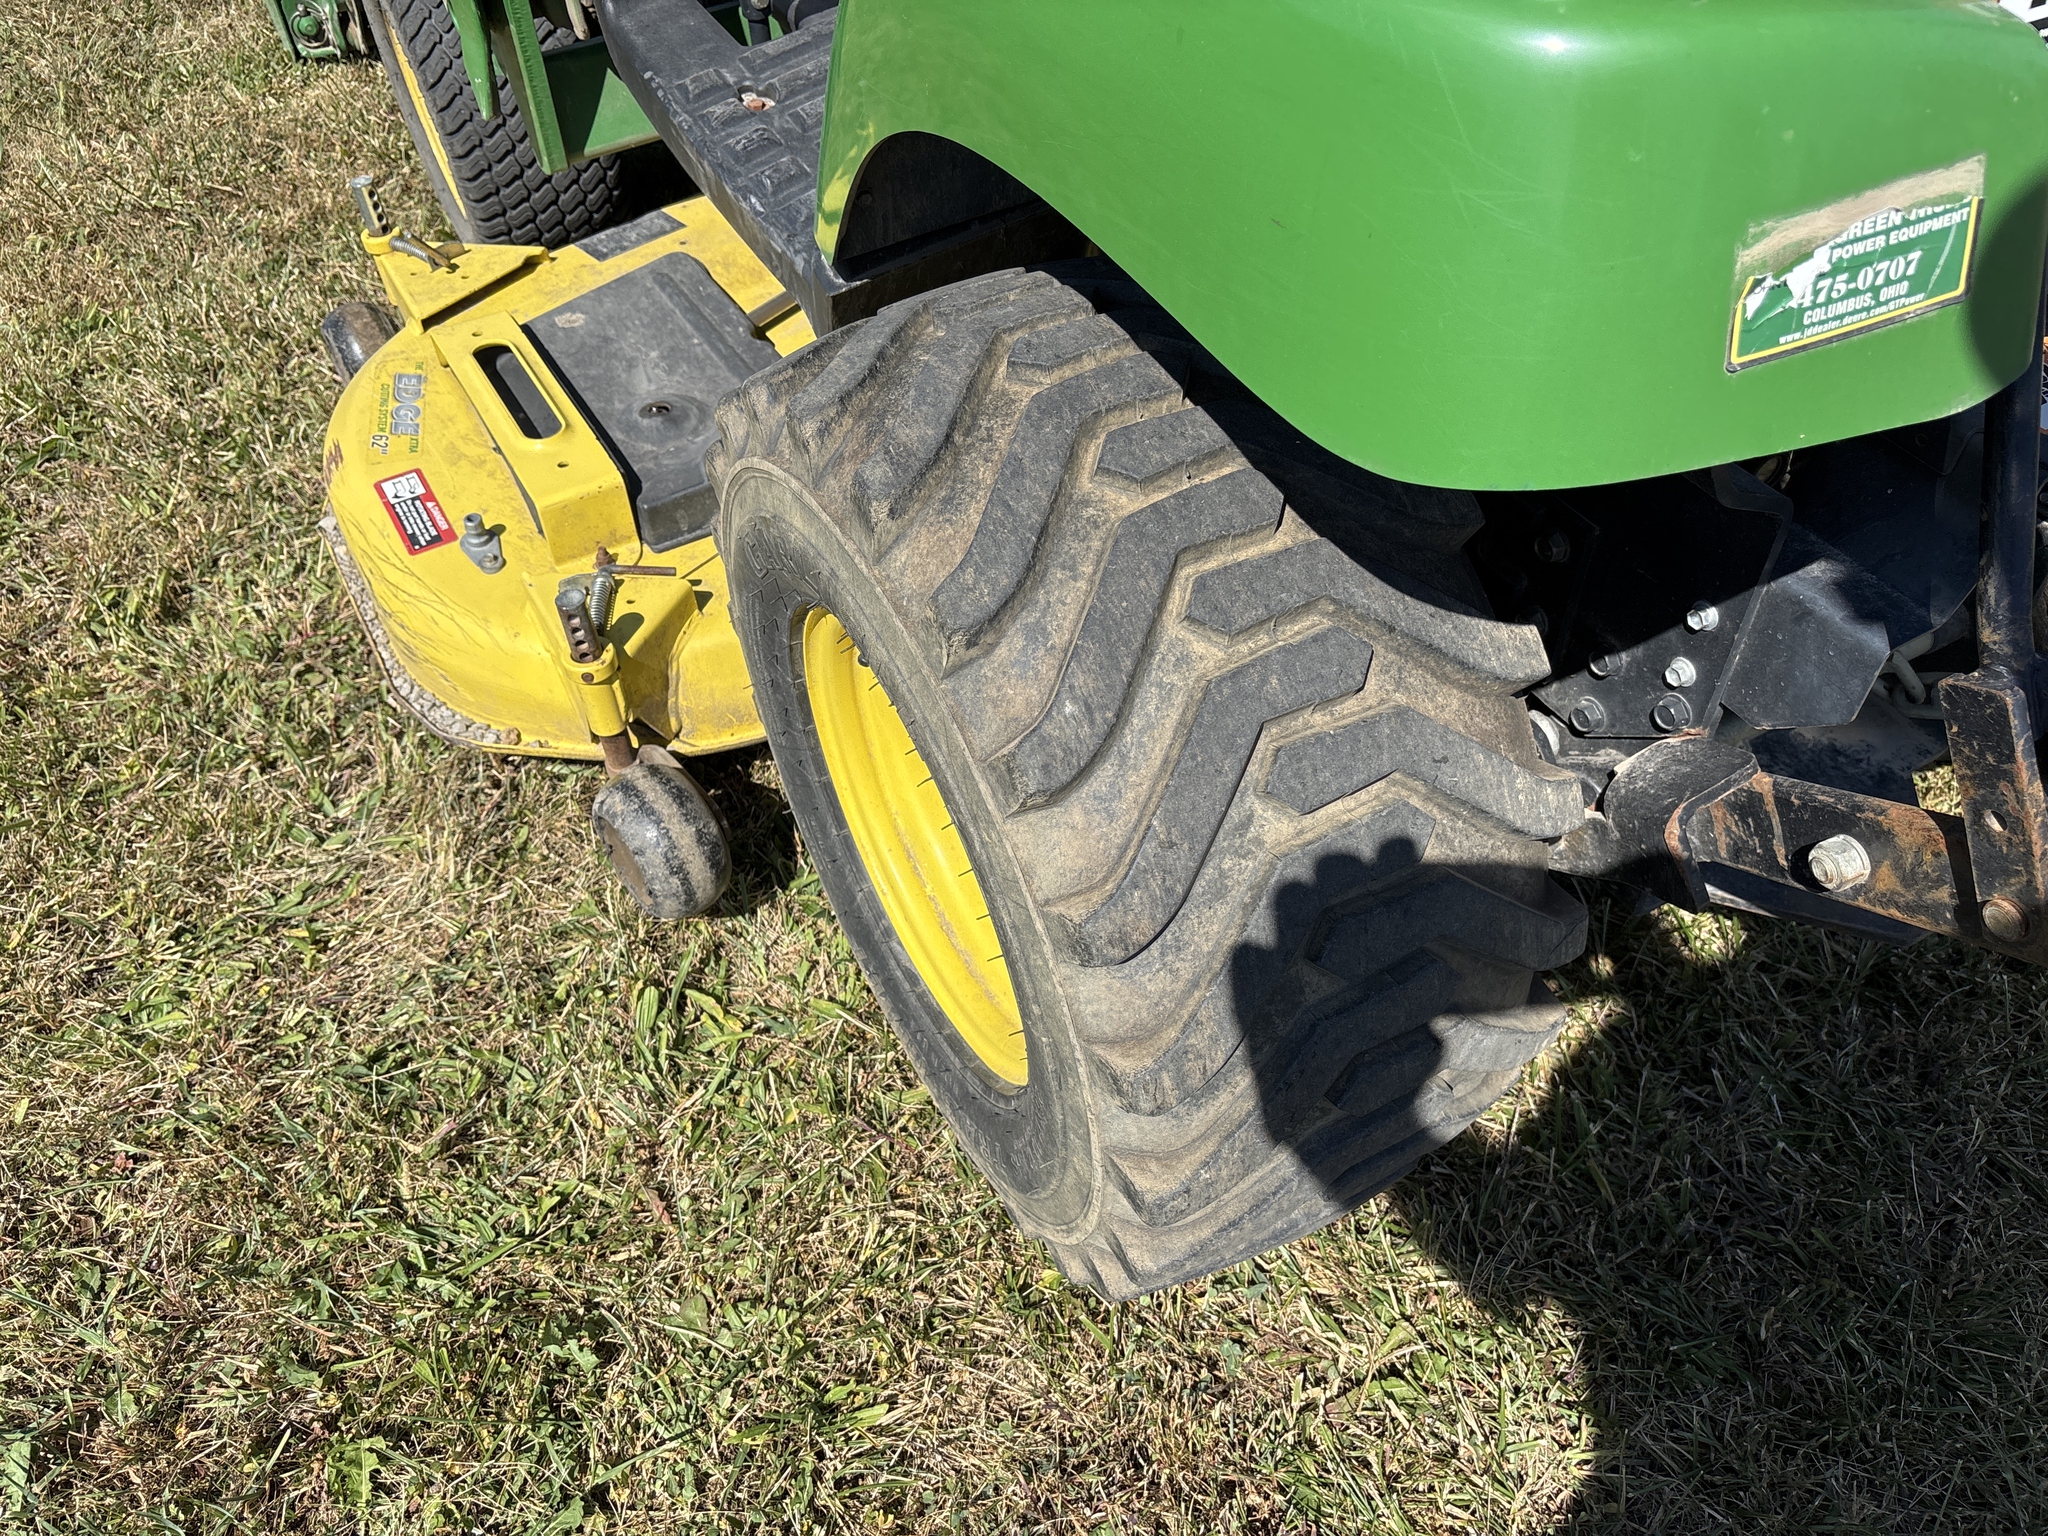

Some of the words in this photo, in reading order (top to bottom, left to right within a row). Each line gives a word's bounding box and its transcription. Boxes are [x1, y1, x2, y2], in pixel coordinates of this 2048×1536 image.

[1832, 235, 1887, 263] POWER
[1889, 207, 1970, 245] EQUIPMENT
[1797, 250, 1922, 308] 475-0707
[1803, 292, 1876, 325] COLUMBUS,
[1879, 280, 1910, 302] OHIO
[1779, 292, 1925, 345] www.jddealer.deere.com/GTPower
[379, 383, 390, 408] CUTTING
[392, 372, 423, 436] EDGE
[408, 437, 420, 454] XTRA
[377, 409, 389, 433] SYSTEM
[430, 505, 449, 531] DANGER
